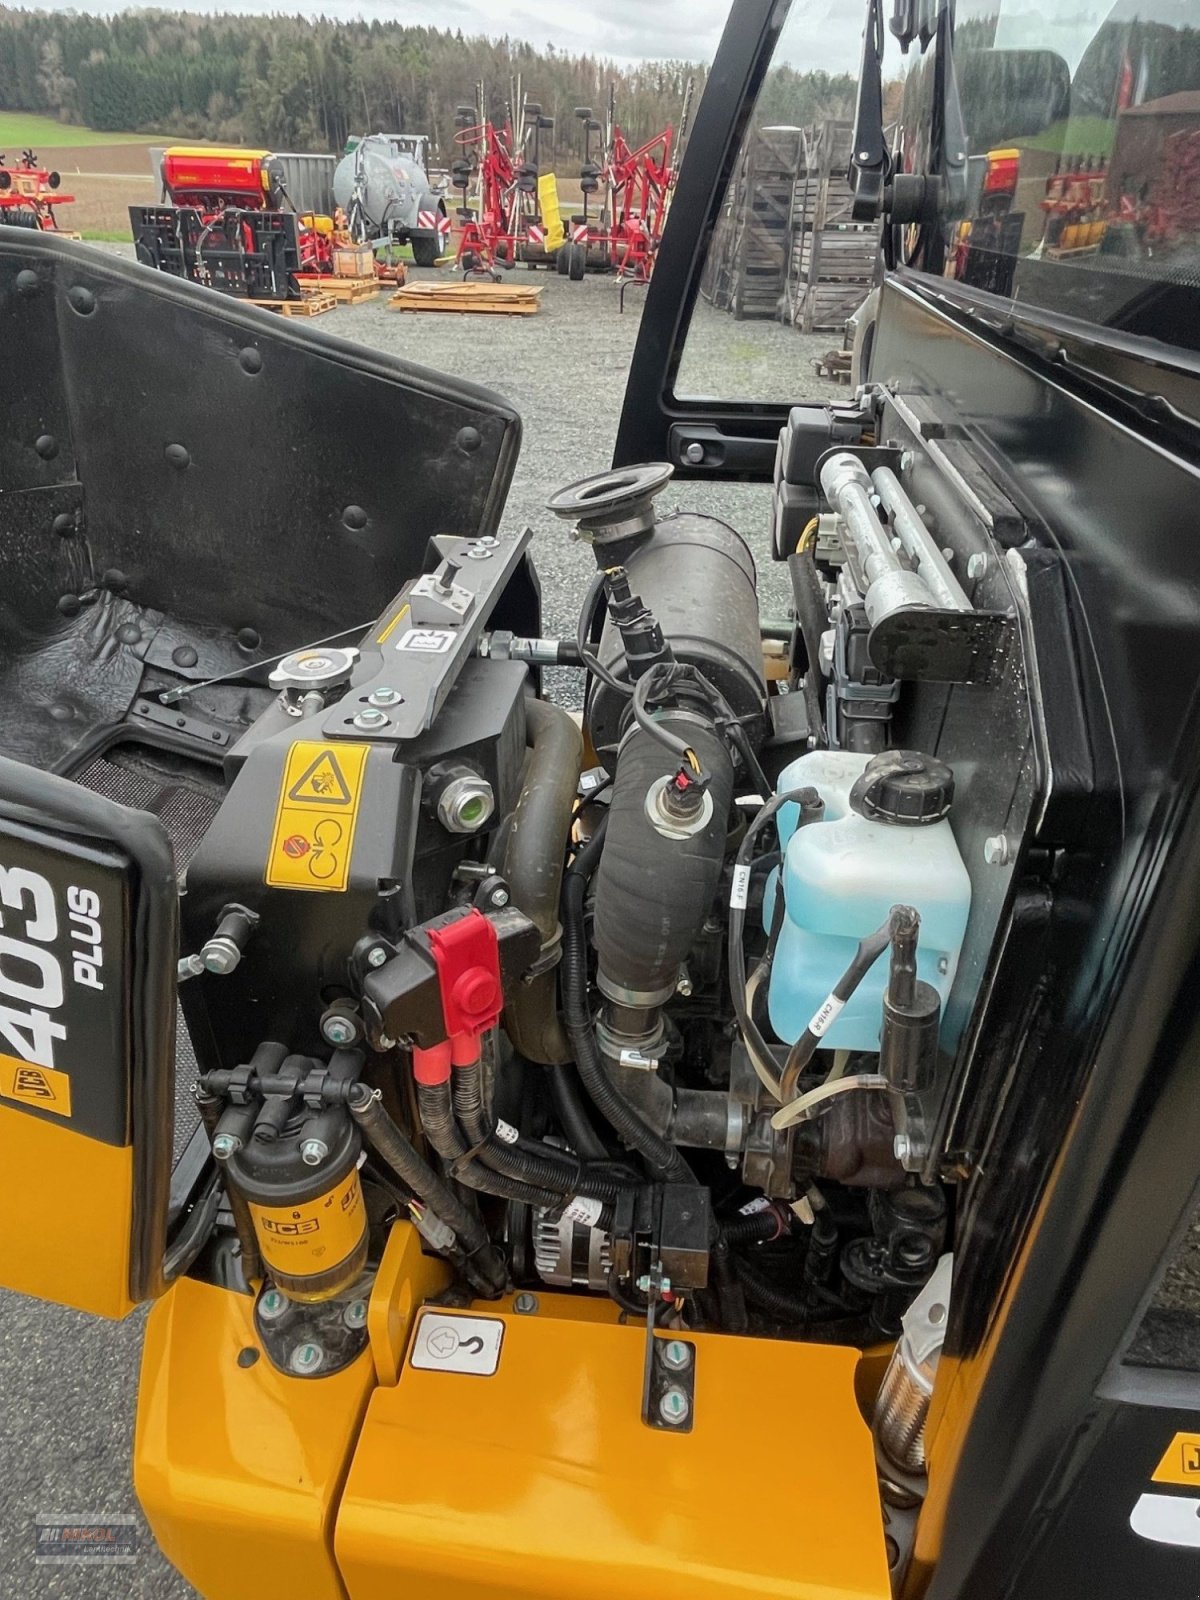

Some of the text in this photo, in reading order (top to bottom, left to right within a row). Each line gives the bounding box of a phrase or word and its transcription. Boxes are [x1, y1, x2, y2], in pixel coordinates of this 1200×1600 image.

[0, 864, 67, 1069] 403
[66, 885, 104, 991] PLUS
[17, 1070, 52, 1097] JCB
[262, 1217, 320, 1236] JCB
